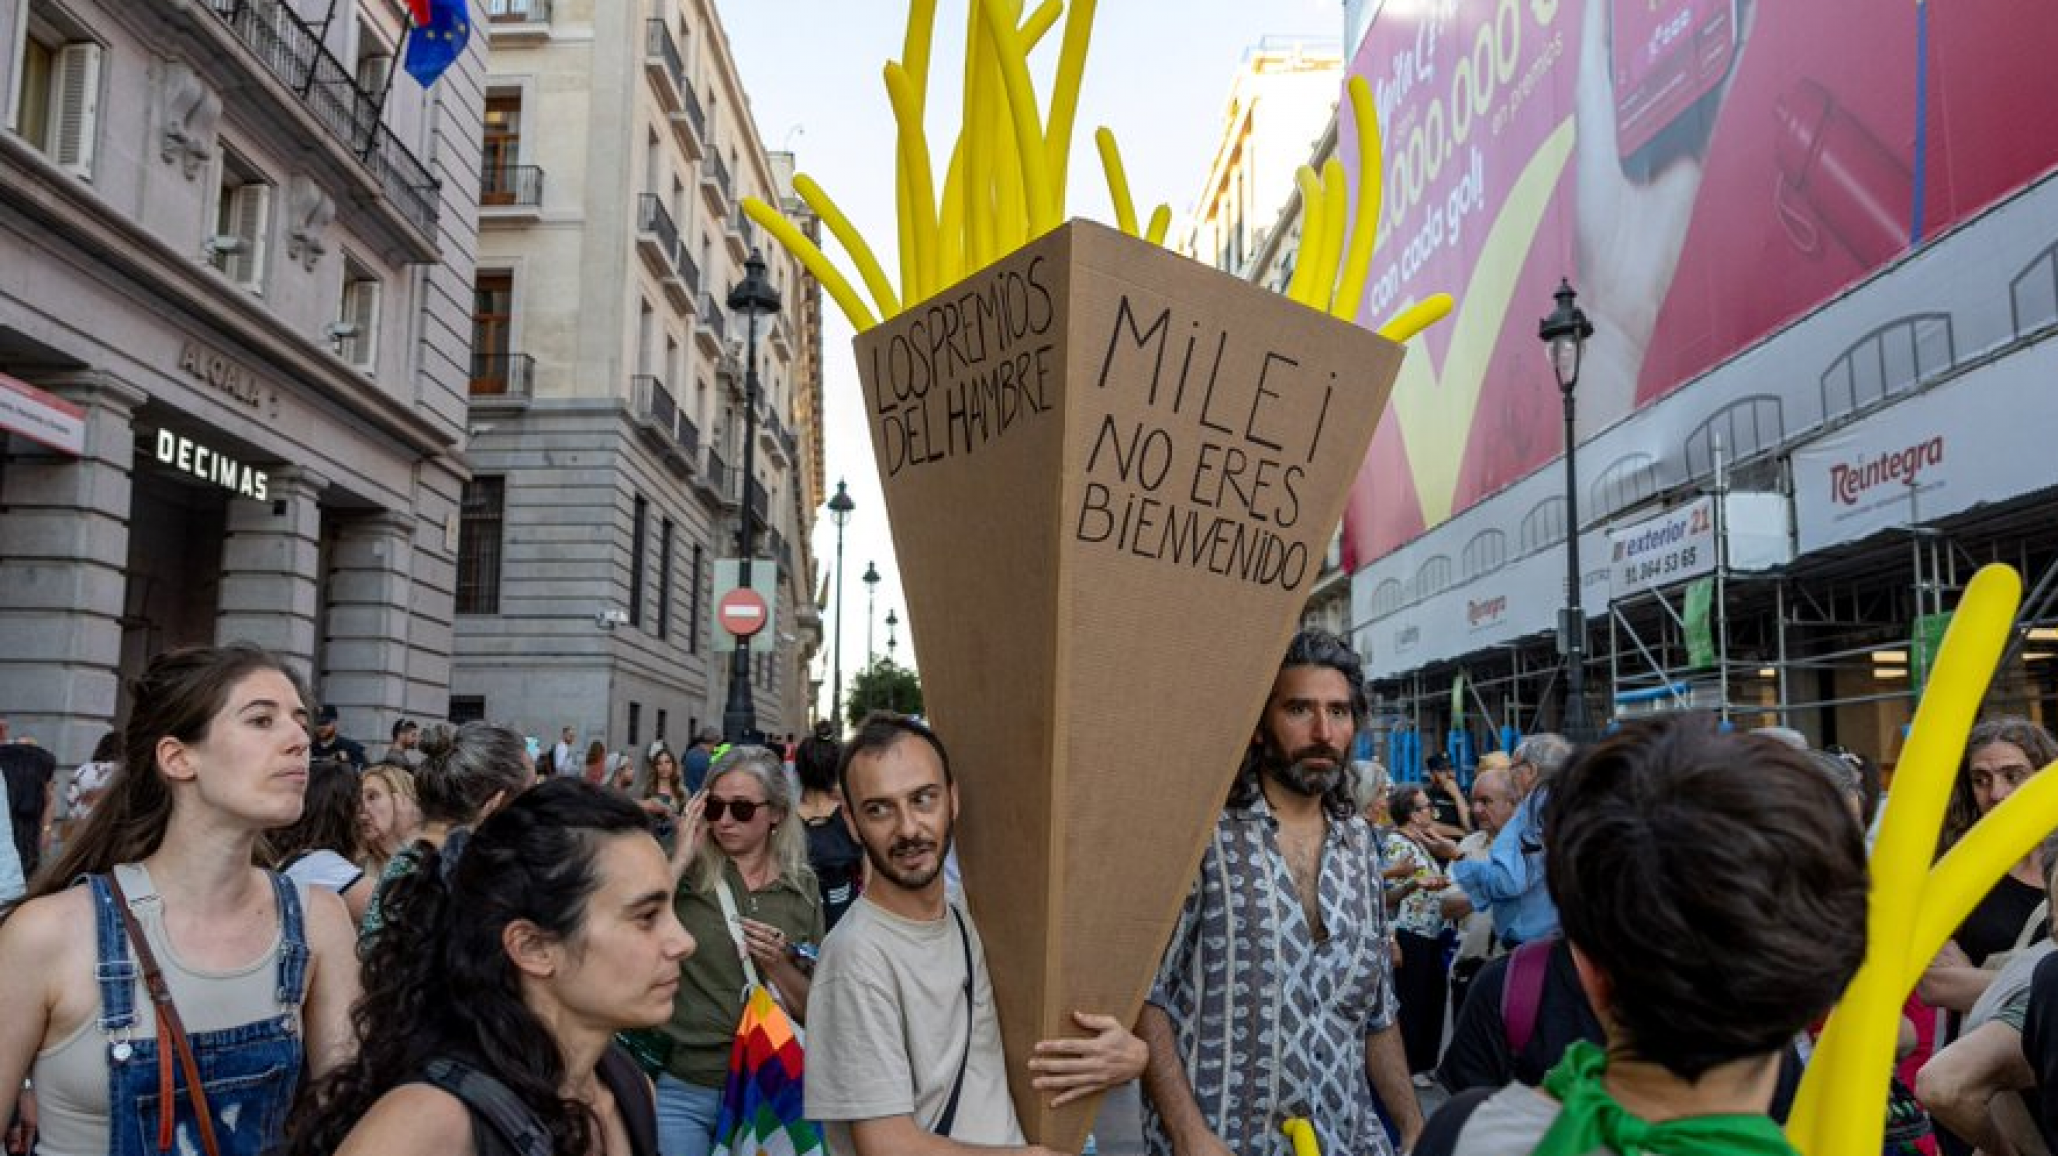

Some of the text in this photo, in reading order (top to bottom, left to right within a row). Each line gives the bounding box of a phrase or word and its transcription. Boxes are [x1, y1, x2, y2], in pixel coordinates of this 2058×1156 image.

[1374, 0, 1521, 254] .000.000
[1370, 262, 1399, 318] con
[1401, 204, 1443, 281] cada
[156, 427, 269, 501] DECIMAS
[883, 344, 1054, 478] DEL HAMBRE
[1086, 413, 1305, 529] NO ERES
[1829, 434, 1943, 505] Reintegra
[1627, 505, 1710, 556] exterior 21
